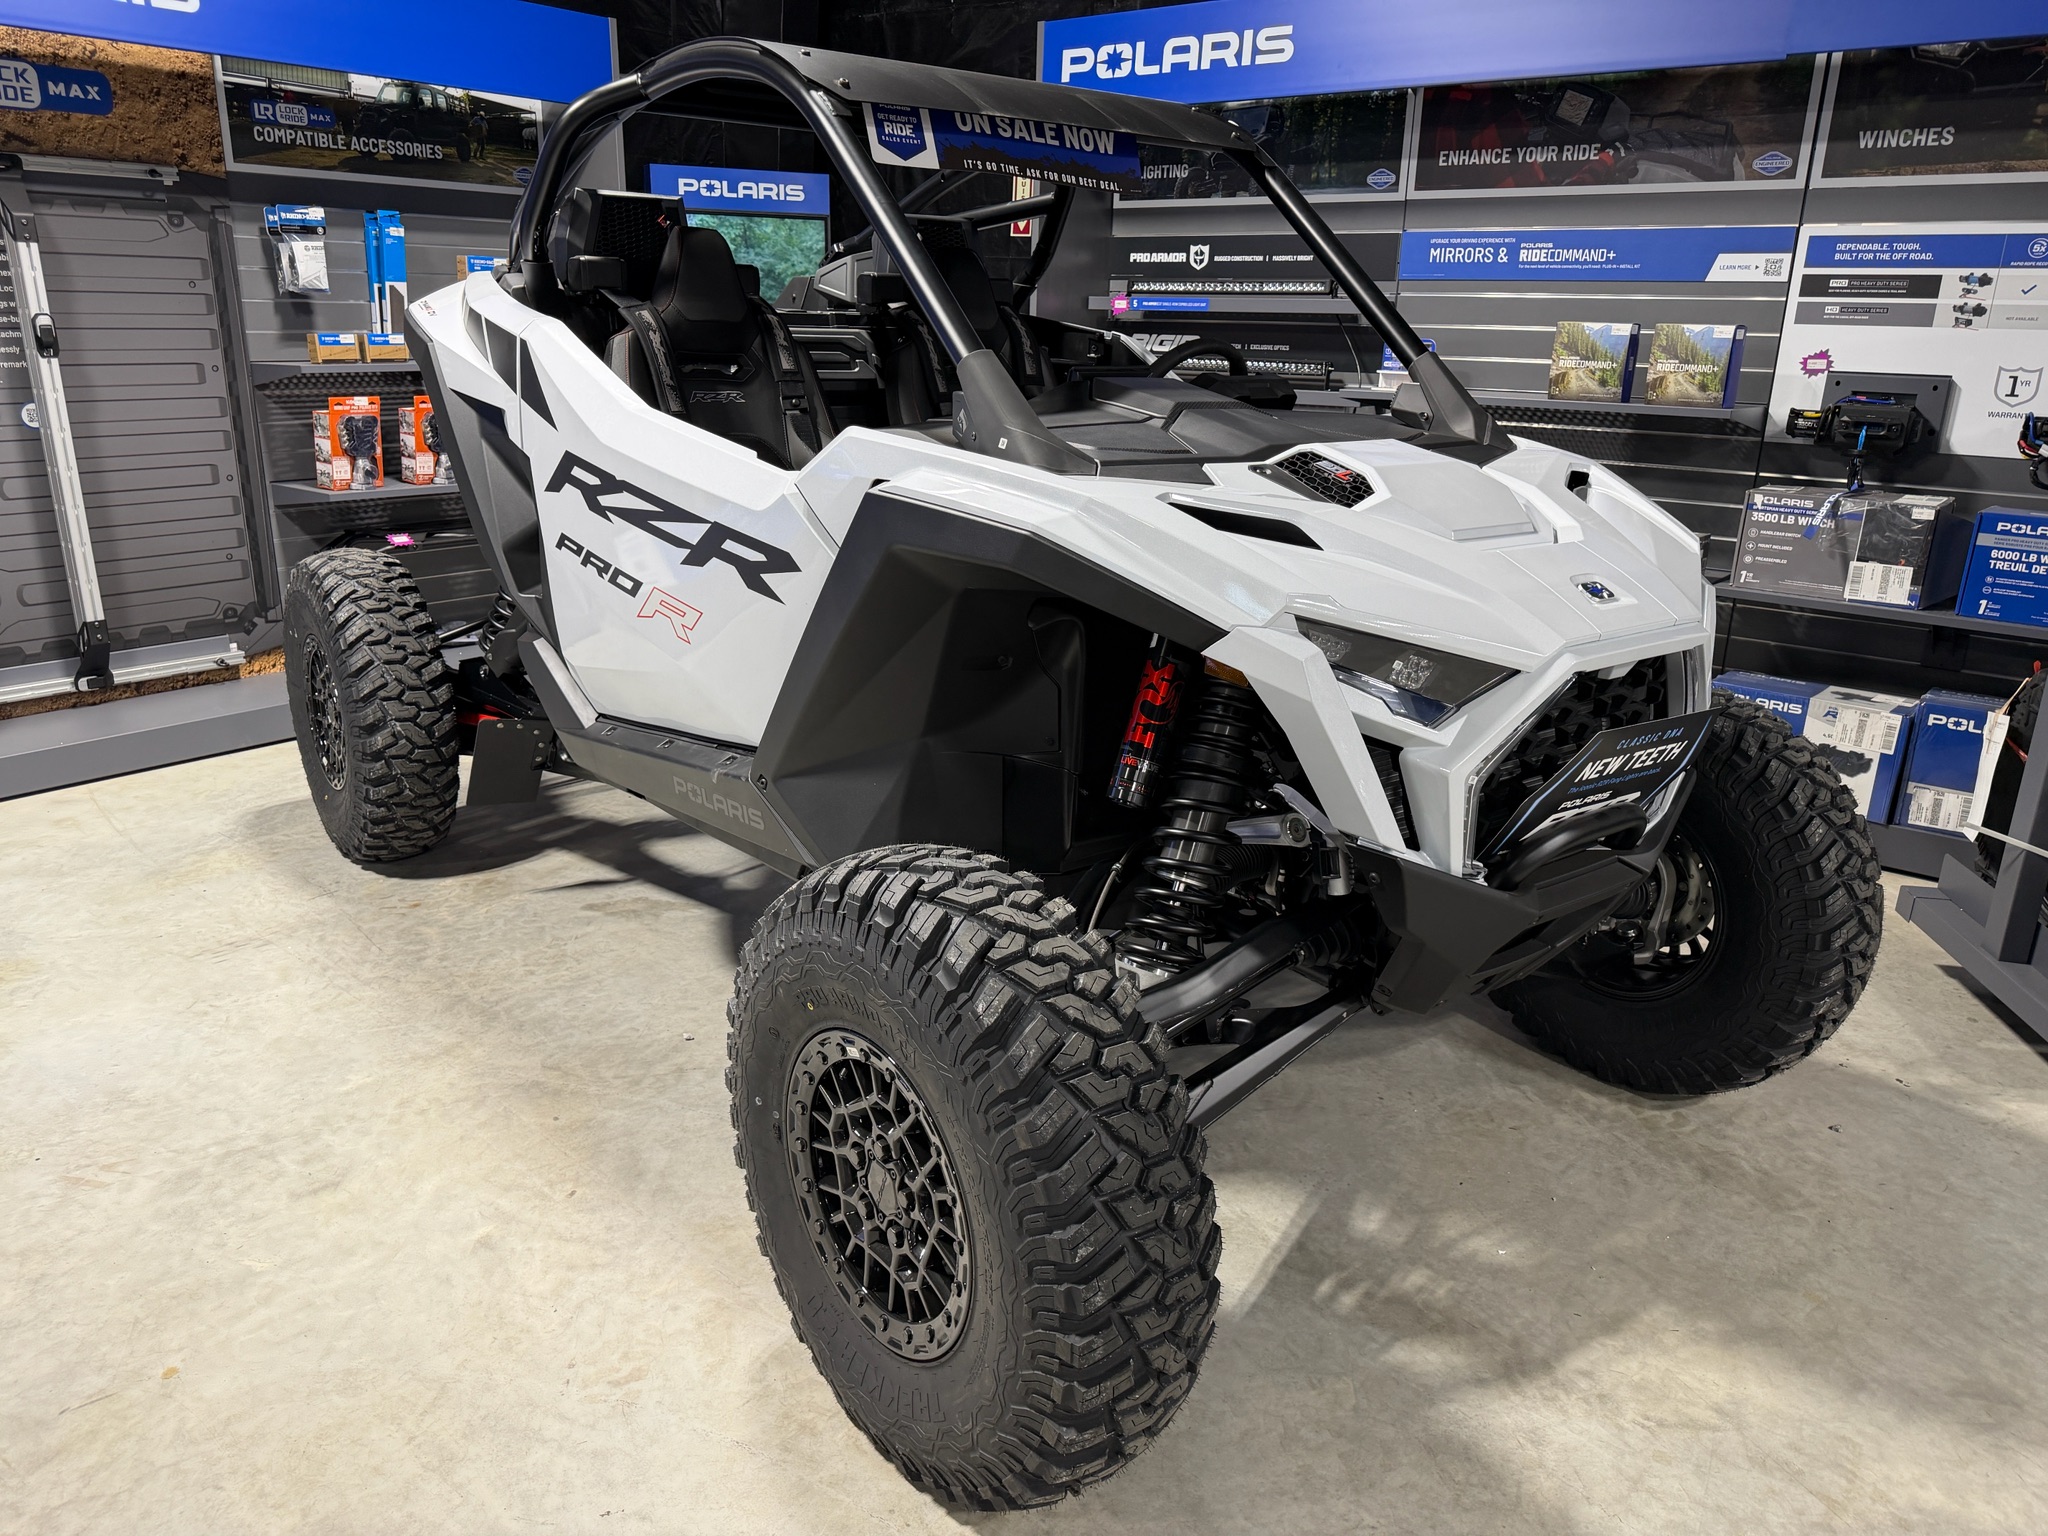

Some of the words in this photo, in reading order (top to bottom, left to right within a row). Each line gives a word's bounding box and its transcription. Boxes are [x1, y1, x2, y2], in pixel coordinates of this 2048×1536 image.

[1061, 25, 1294, 83] POLARIS
[47, 80, 101, 100] MAX
[253, 102, 276, 121] LR
[278, 106, 304, 116] LOCK
[310, 113, 331, 122] MAX
[877, 112, 888, 120] GET
[889, 114, 908, 123] READY
[909, 116, 917, 124] TO
[253, 125, 347, 150] COMPATIBLE
[350, 136, 443, 160] ACCESSORIES
[882, 135, 900, 143] SALES
[954, 112, 991, 135] ON
[997, 117, 1060, 146] SALE
[1063, 126, 1115, 155] NOW
[1857, 126, 1956, 150] WINCHES
[1438, 147, 1513, 167] ENHANCE
[1516, 145, 1559, 165] YOUR
[1561, 143, 1601, 162] RIDE
[963, 159, 983, 170] IT'S
[985, 162, 998, 172] GO
[1000, 163, 1024, 176] TIME.
[1026, 168, 1042, 179] ASK
[1044, 171, 1060, 182] FOR
[1061, 173, 1077, 184] OUR
[1079, 176, 1097, 188] BEST
[1099, 180, 1123, 191] DEAL.
[1141, 164, 1189, 180] IGHTING
[677, 177, 806, 202] POLARIS
[1429, 247, 1494, 264] MIRRORS
[1497, 247, 1509, 263] &
[1834, 252, 1857, 260] BUILT
[1892, 252, 1909, 260] OFF
[1909, 252, 1935, 260] ROAD.
[1836, 243, 1891, 251] DEPENDABLE.
[1892, 242, 1922, 251] TOUGH.
[1132, 299, 1138, 307] 5
[2004, 375, 2020, 397] 1
[690, 391, 746, 403] RZR
[544, 450, 803, 606] RZR
[1751, 511, 1778, 522] 3500
[1780, 513, 1795, 525] LB
[1798, 516, 1835, 529] WICH
[1755, 556, 1788, 564] PREASSEMBLED
[1991, 549, 2020, 561] 6000
[2021, 552, 2038, 563] LB
[1740, 570, 1748, 583] 1
[1989, 560, 2029, 573] TREUIL
[2031, 564, 2048, 575] DE
[555, 532, 644, 599] PRO
[637, 586, 704, 645] R
[1978, 599, 1988, 615] 1
[1124, 660, 1176, 748] FOX
[1616, 734, 1663, 750] CLASSIC
[1663, 727, 1684, 740] DNA
[1574, 753, 1632, 783] NEW
[1624, 740, 1689, 771] TEETH
[673, 775, 765, 830] POLARIS
[1557, 790, 1614, 811] POLARIS
